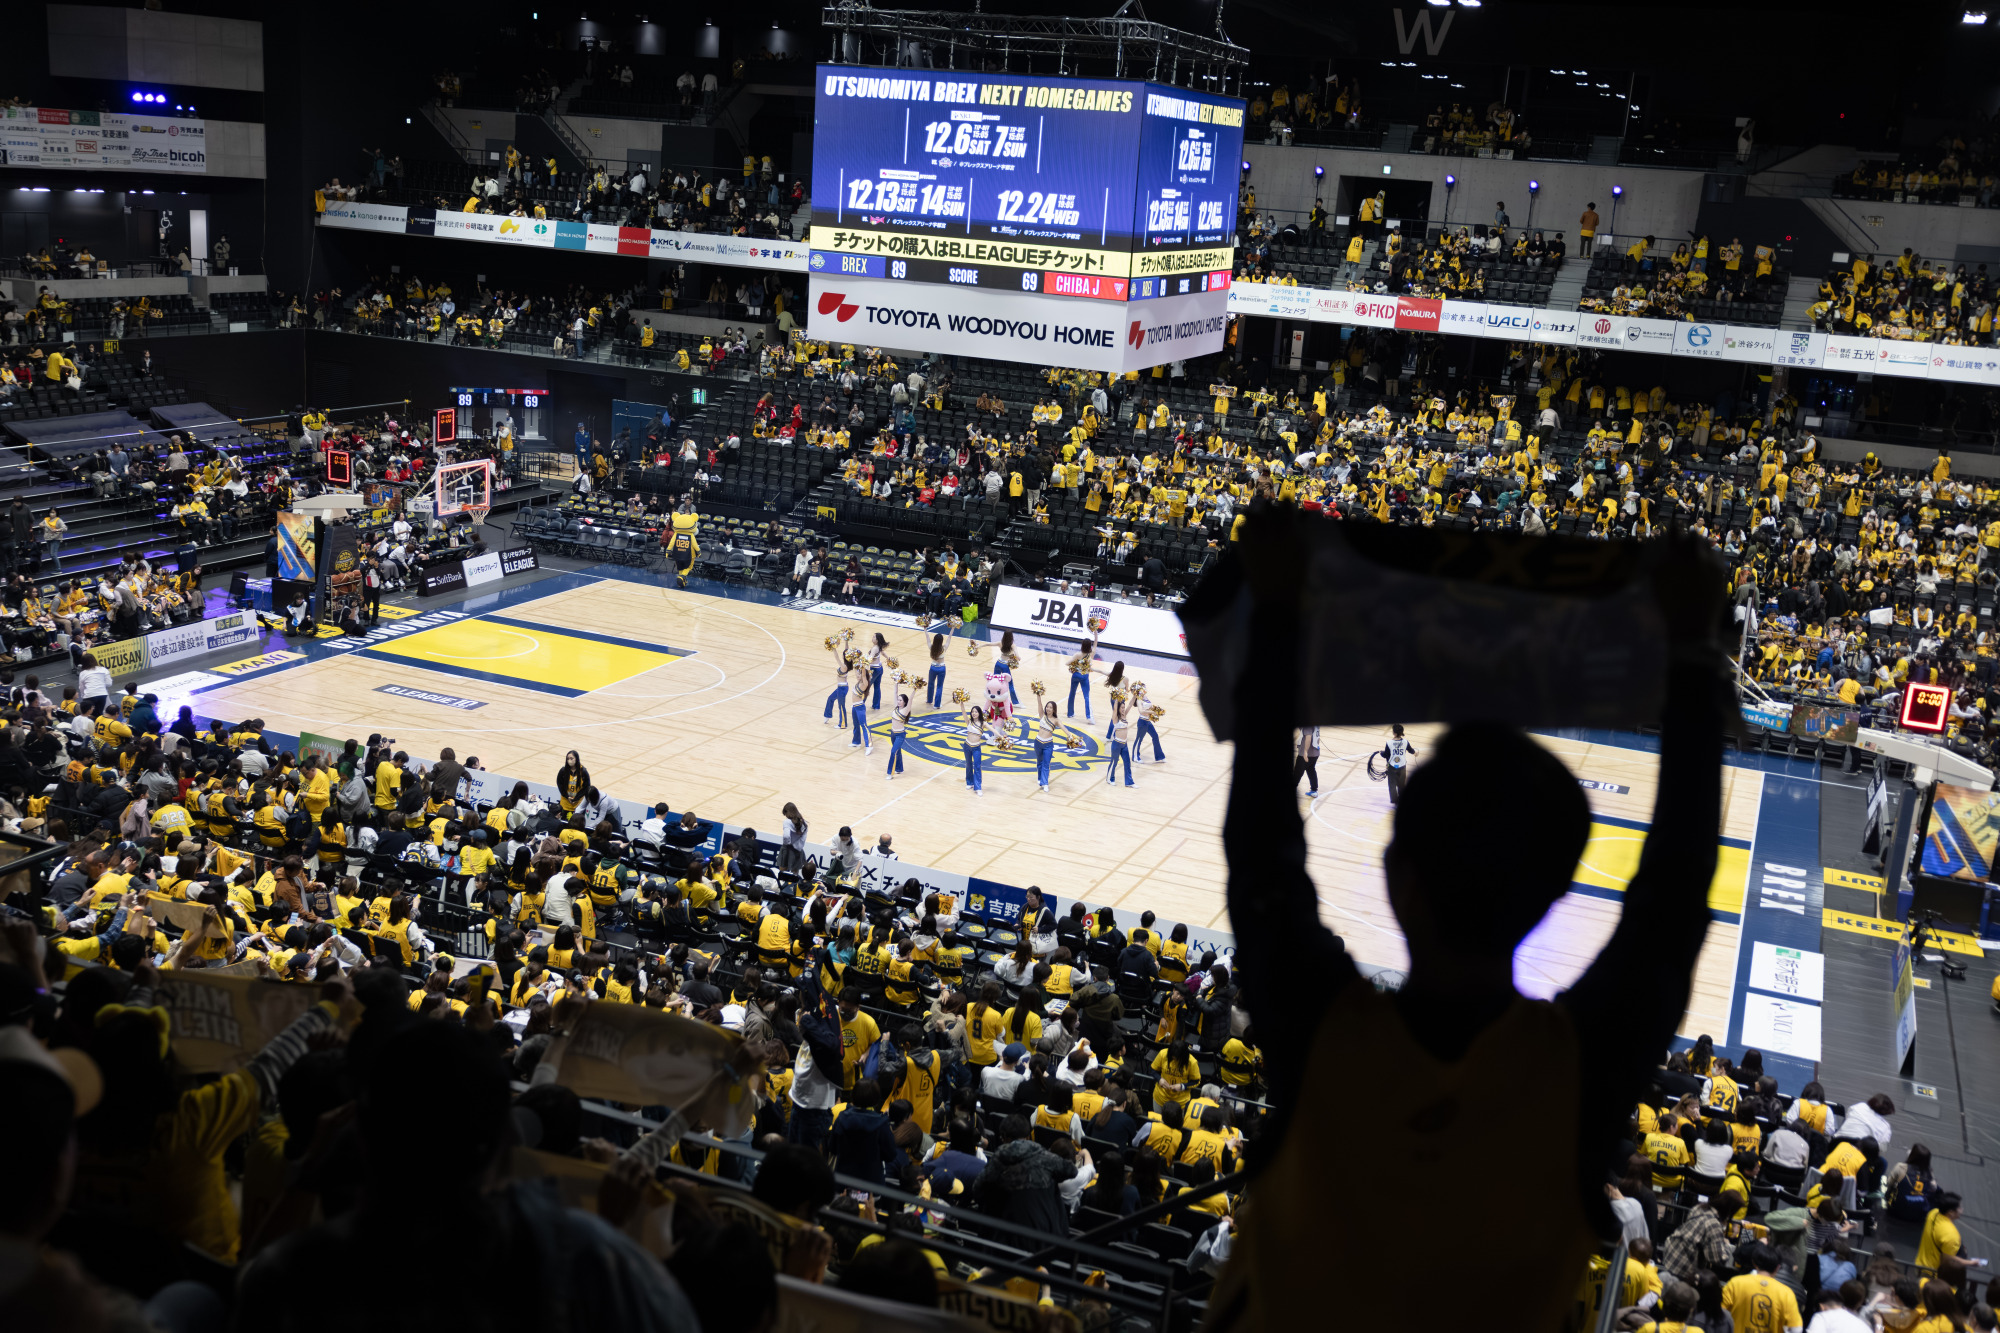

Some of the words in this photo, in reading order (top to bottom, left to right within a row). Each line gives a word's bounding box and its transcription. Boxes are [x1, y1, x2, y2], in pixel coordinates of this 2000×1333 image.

[1393, 8, 1456, 56] W
[824, 76, 930, 101] UTSUNOMIYA
[934, 82, 978, 104] BREX
[979, 84, 1024, 106] NEXT
[1024, 87, 1133, 113] HOMEGAMES
[77, 142, 96, 150] TSK
[925, 122, 972, 154] 12.6
[992, 126, 1009, 156] 7
[132, 148, 148, 159] Big
[147, 149, 168, 158] Tree
[170, 149, 205, 162] bicoh
[968, 140, 991, 156] SAT
[1003, 142, 1027, 158] SUN
[848, 179, 900, 212] 12.13
[921, 184, 946, 216] 14
[897, 197, 918, 212] SAT
[942, 200, 965, 216] SUN
[997, 190, 1058, 224] 12.24
[358, 212, 377, 220] kanae
[1054, 210, 1080, 225] WED
[842, 256, 867, 273] BREX
[892, 261, 906, 278] 89
[949, 268, 978, 284] SCORE
[1022, 272, 1038, 291] 69
[1056, 276, 1090, 294] CHIBA
[1092, 279, 1100, 295] J
[1369, 304, 1395, 319] FKD
[1400, 310, 1436, 319] NOMURA
[1451, 314, 1484, 324] 前原土建
[866, 306, 941, 330] TOYOTA
[948, 314, 1047, 341] WOODYOU
[1054, 326, 1114, 347] HOME
[1487, 315, 1530, 327] UACJ
[1550, 324, 1576, 332] カナメ
[1148, 325, 1172, 345] TOYOTA
[1206, 316, 1223, 333] HOME
[1738, 340, 1772, 350] 渋谷タイル
[1852, 349, 1875, 360] 五光
[459, 394, 472, 406] 89
[524, 395, 538, 407] 69
[676, 540, 689, 548] 028
[504, 557, 535, 574] B.LEAGUE
[436, 571, 463, 585] SoftBank
[1031, 598, 1084, 628] JBA
[1090, 607, 1110, 616] JAPAN
[322, 610, 470, 649] UTSUNOMIYA
[231, 654, 289, 672] MANI
[385, 686, 452, 705] B.LEAGUE
[1917, 691, 1943, 707] 0:00
[94, 722, 106, 736] 42
[161, 811, 184, 825] 028
[489, 815, 500, 825] 7
[1760, 862, 1807, 915] BREX
[988, 899, 1021, 918] 吉野
[1837, 917, 1902, 934] KEEP
[857, 954, 879, 973] 028
[972, 1018, 982, 1038] 9
[1712, 1090, 1735, 1113] 34
[1656, 1150, 1668, 1165] 6
[1751, 1293, 1772, 1328] 6
